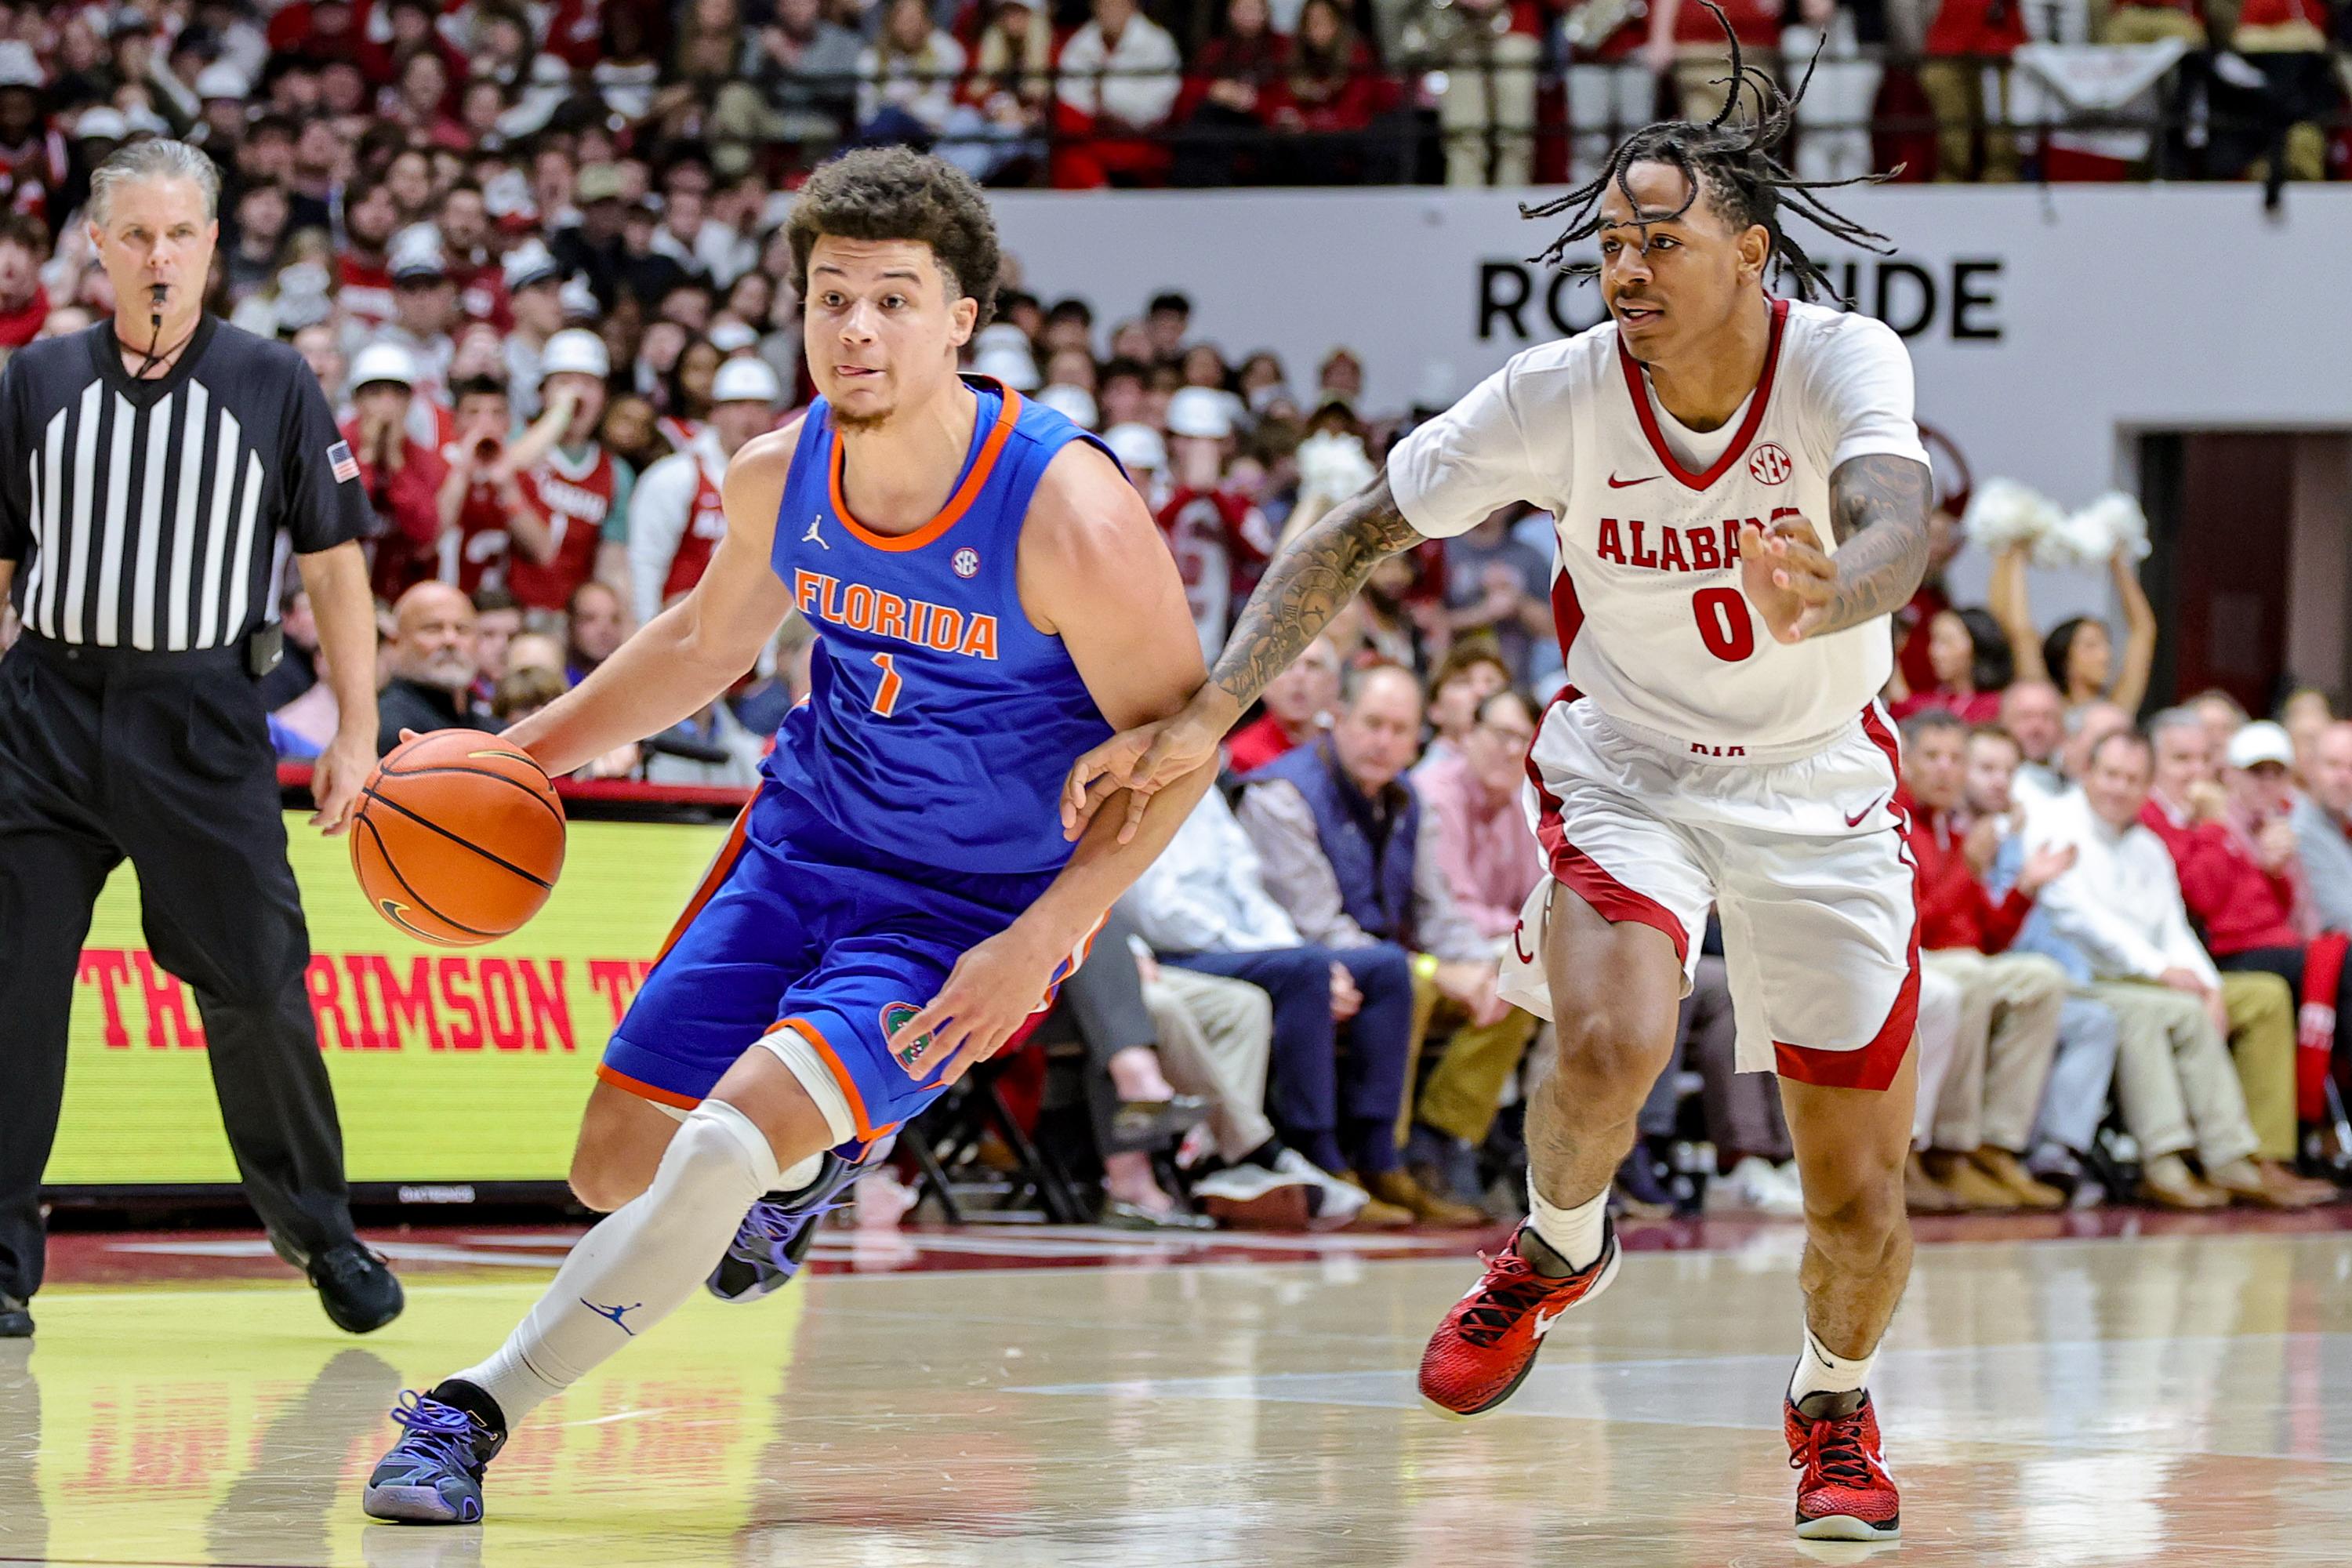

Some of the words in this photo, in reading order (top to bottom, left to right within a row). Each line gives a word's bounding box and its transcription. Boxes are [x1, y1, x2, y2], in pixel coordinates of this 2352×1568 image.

[1480, 263, 1613, 338] RO
[1750, 446, 1791, 484] SEC
[954, 550, 978, 576] SEC
[1597, 507, 1801, 572] ALABA
[794, 568, 999, 660] FLORIDA
[1693, 587, 1754, 662] 0
[870, 652, 902, 718] 1
[79, 949, 209, 1047] TH
[304, 954, 575, 1051] RIMSON
